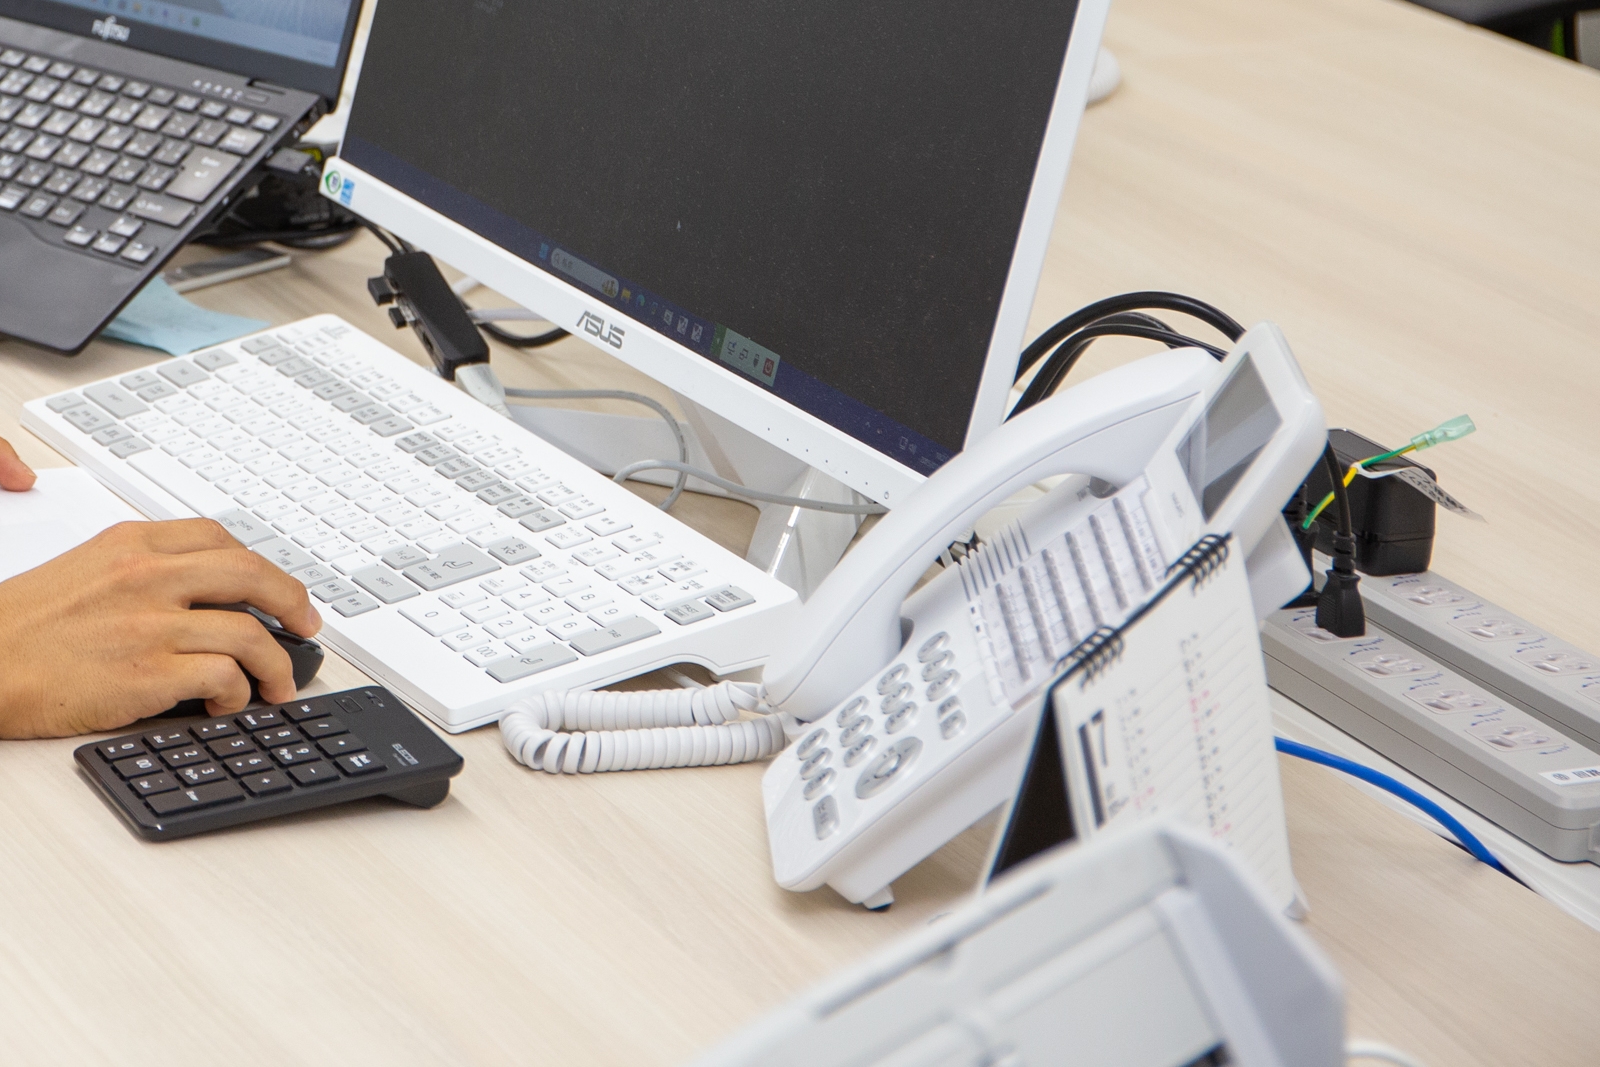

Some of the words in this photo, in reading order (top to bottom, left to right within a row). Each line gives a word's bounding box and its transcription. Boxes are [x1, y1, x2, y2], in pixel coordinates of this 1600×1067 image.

[92, 15, 130, 42] FUJITSU
[576, 310, 626, 350] ASUS
[376, 577, 393, 586] SHIFT
[476, 647, 497, 657] 000
[392, 744, 418, 764] ELECOM
[136, 759, 151, 768] 00
